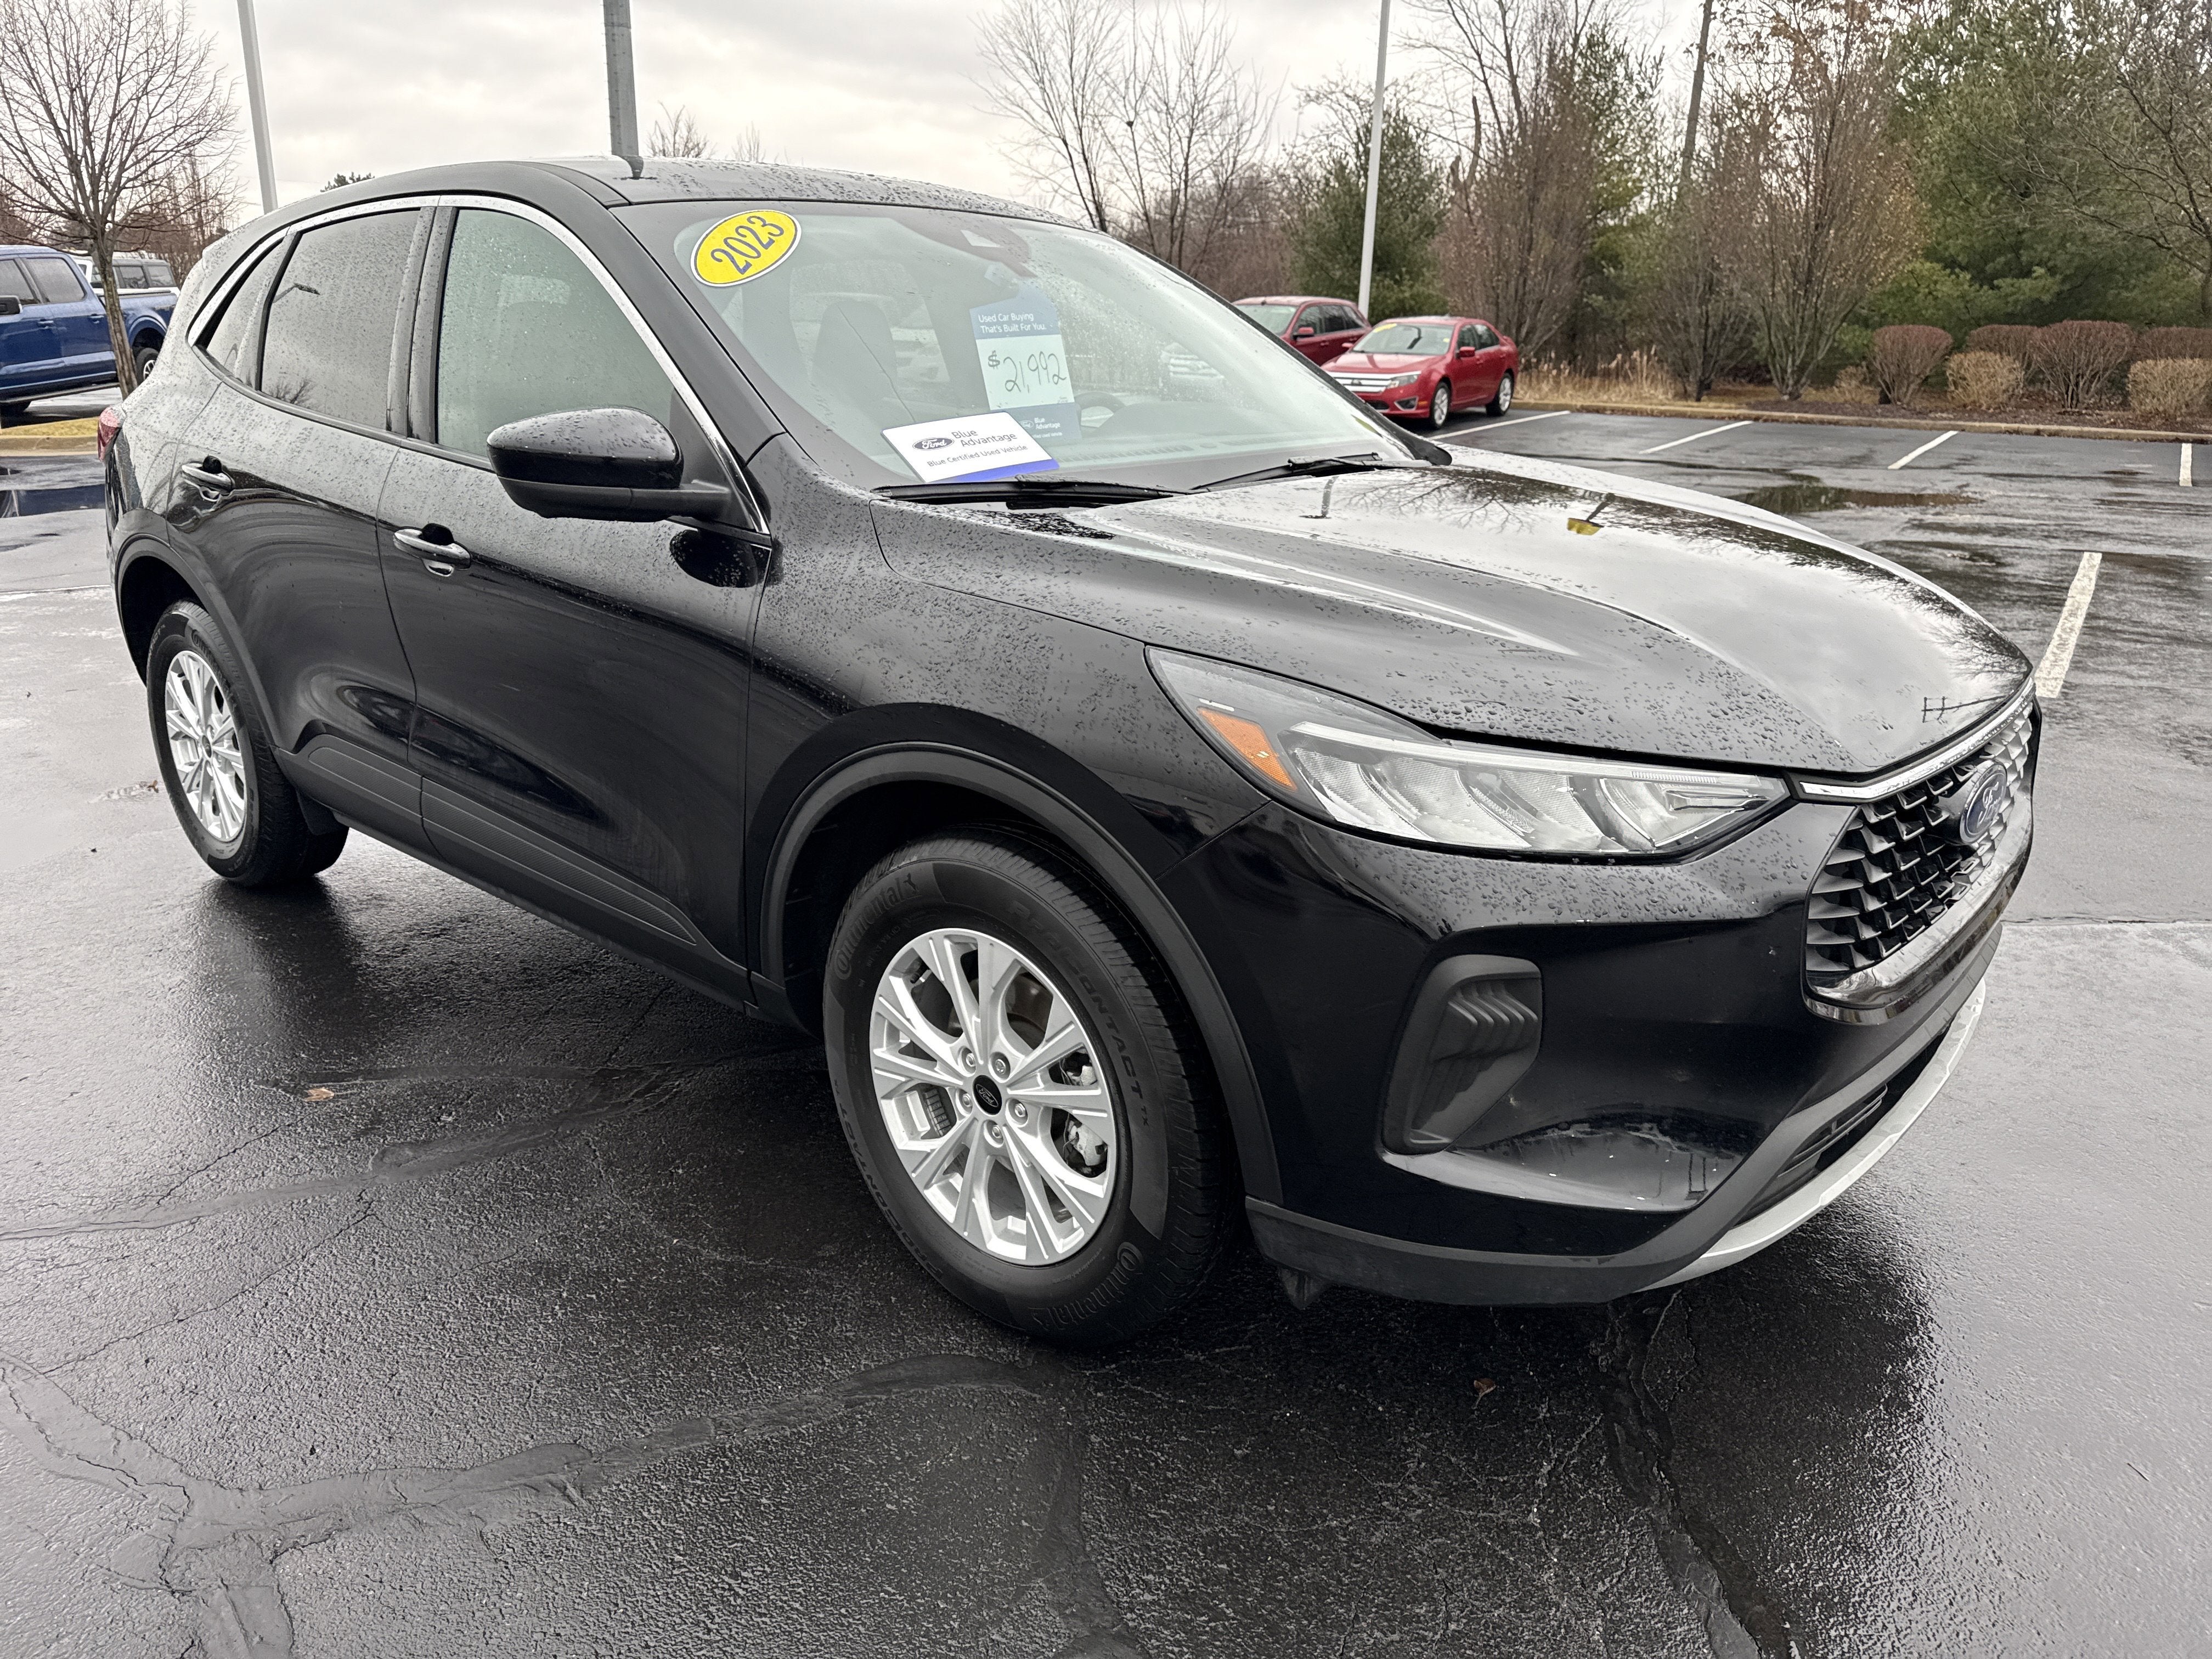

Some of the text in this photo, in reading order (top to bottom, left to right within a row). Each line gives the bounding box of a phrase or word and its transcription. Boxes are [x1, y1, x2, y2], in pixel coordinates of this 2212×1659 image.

[710, 215, 784, 275] 2023
[978, 312, 1034, 324] Used Car Buying
[980, 324, 1003, 334] That's
[1003, 324, 1019, 332] Built
[1020, 323, 1031, 331] For
[921, 432, 1018, 449] Ford Advantage
[951, 428, 978, 439] Blue
[927, 444, 1028, 467] Blue Certified Used Vehicle
[1977, 781, 2002, 825] Ford
[979, 1088, 995, 1104] Ford
